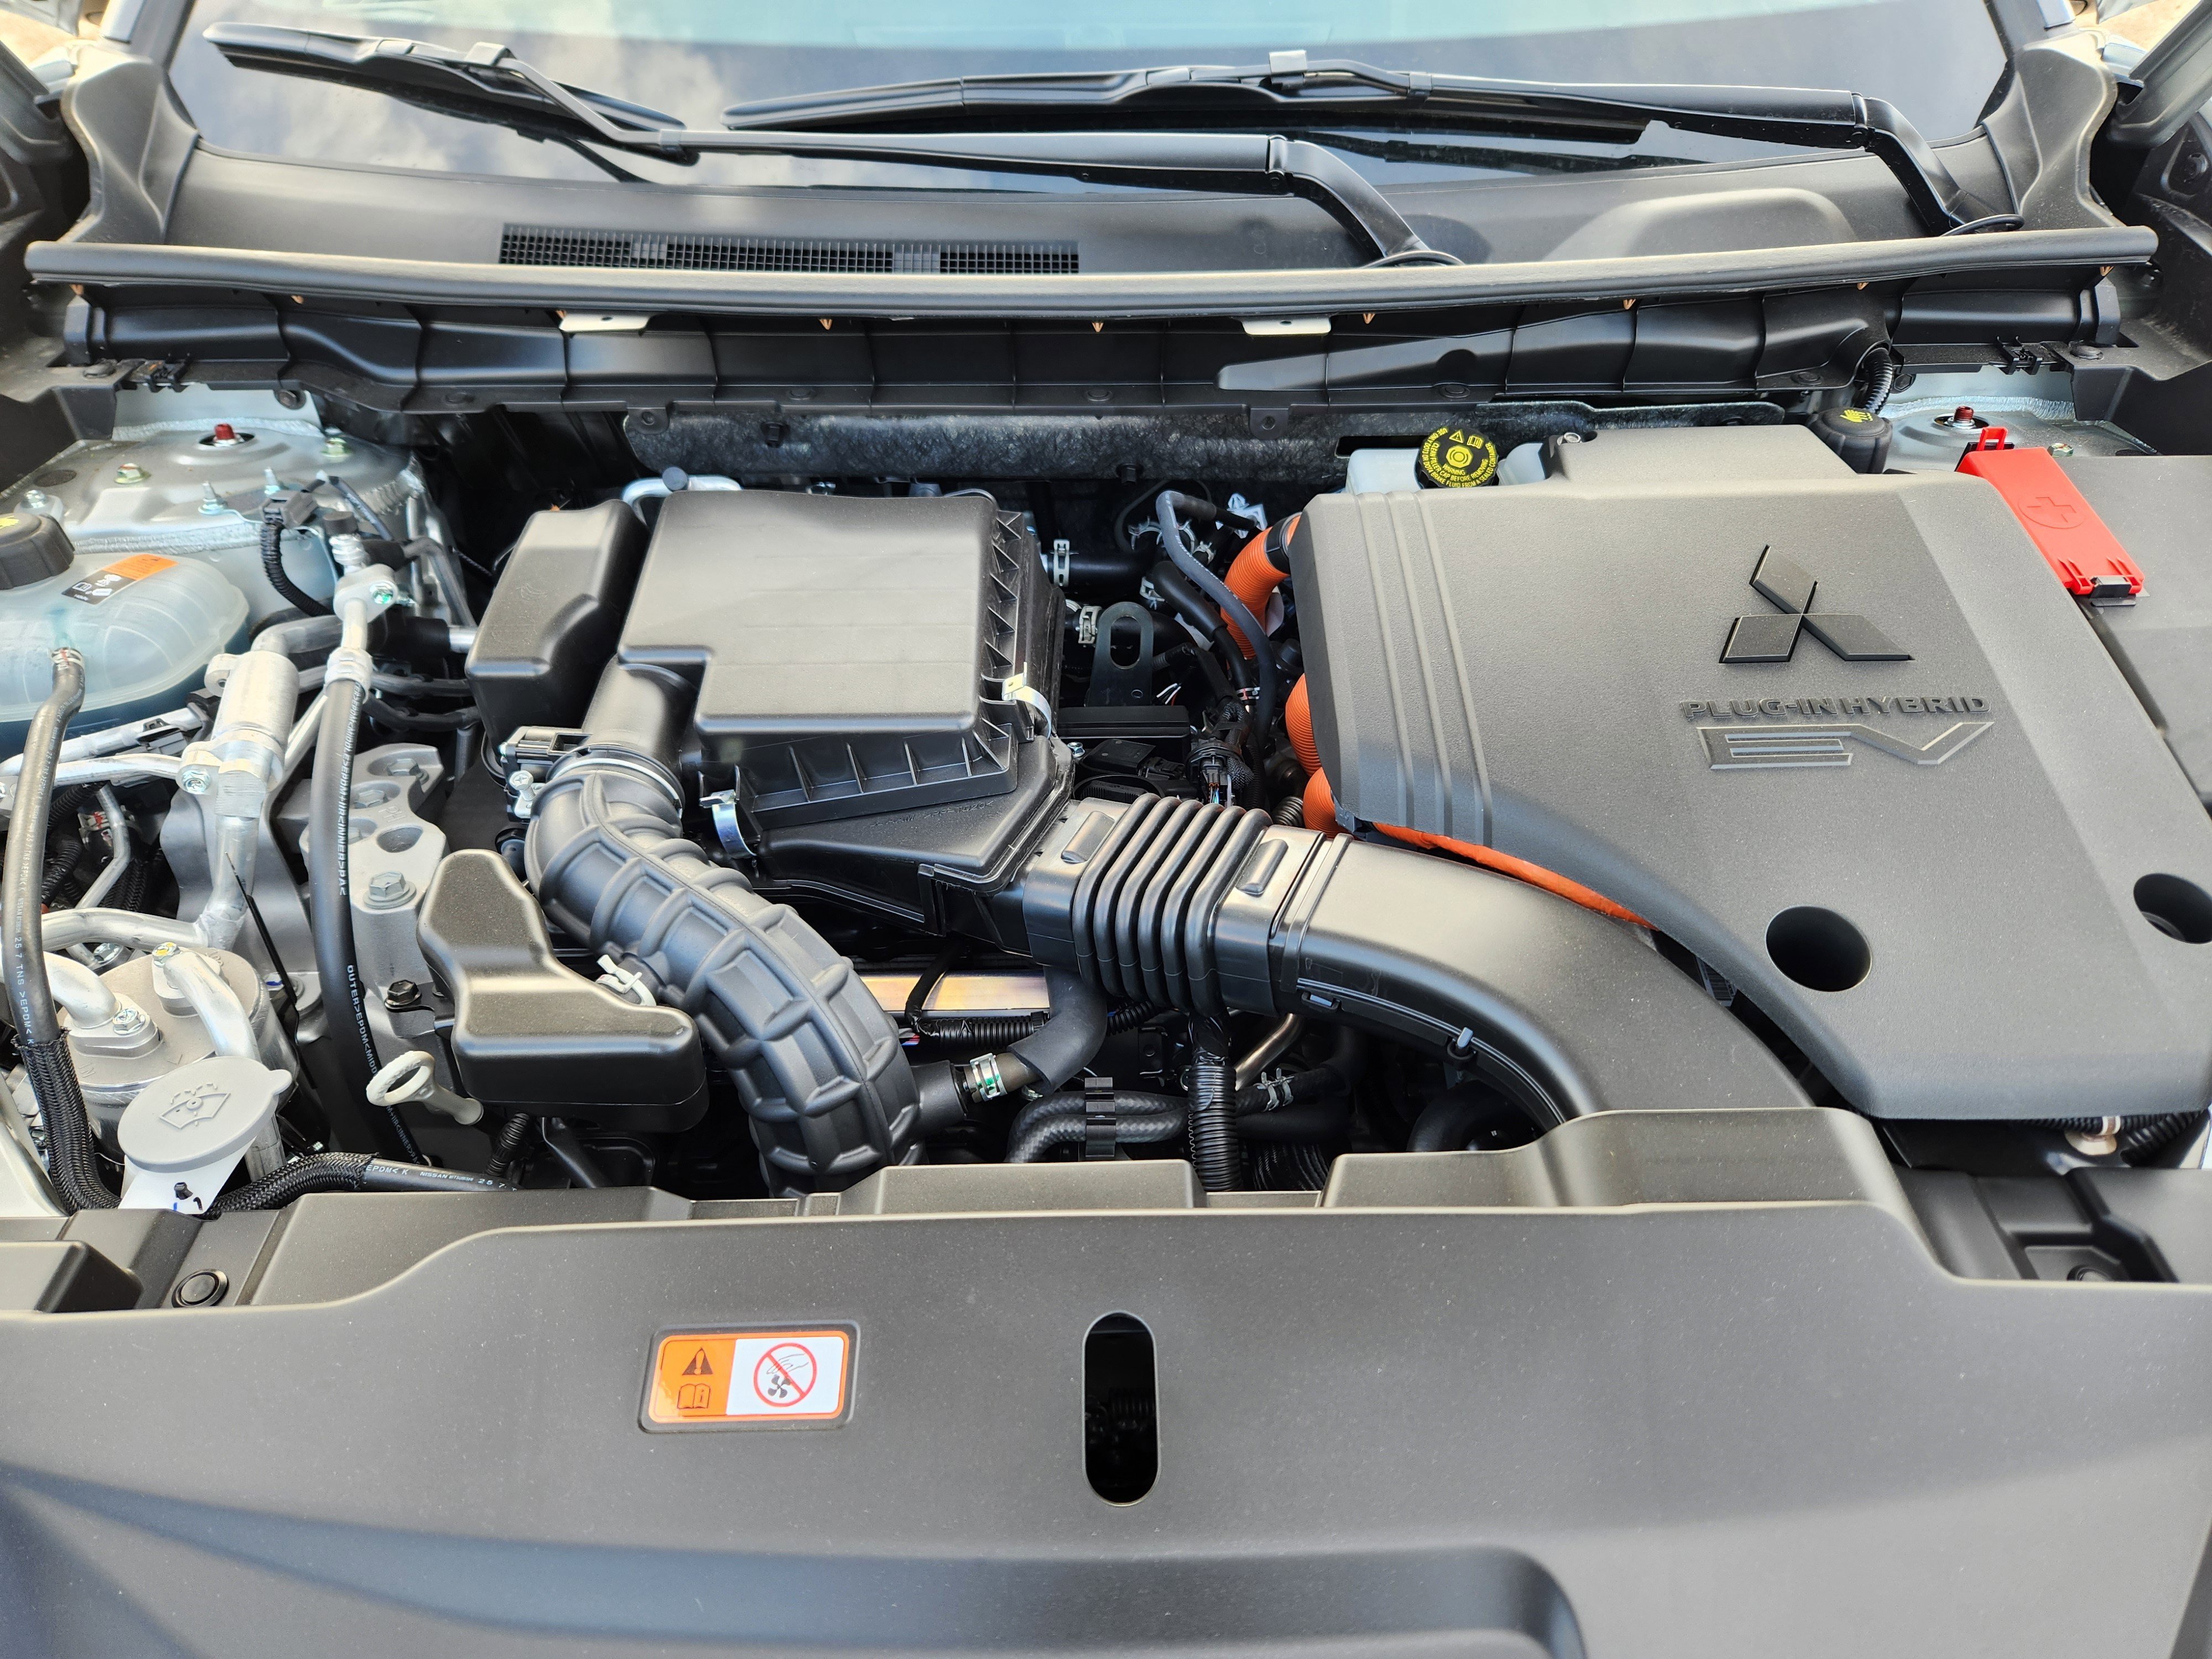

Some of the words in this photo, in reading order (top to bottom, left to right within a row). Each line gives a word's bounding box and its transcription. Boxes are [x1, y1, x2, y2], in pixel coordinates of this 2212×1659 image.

[1427, 433, 1438, 444] ONLY
[1438, 427, 1448, 436] USE
[1430, 443, 1440, 457] CLEAN
[1485, 442, 1497, 469] CONTAINER
[1430, 457, 1441, 472] FILLER
[1443, 463, 1465, 476] WARNING
[1471, 459, 1488, 479] REMOVING
[1431, 472, 1446, 484] BRAKE
[1479, 469, 1493, 482] SEALED
[1680, 697, 1837, 718] PLUG-IN
[1840, 696, 1991, 714] HYBRID
[1697, 722, 1994, 769] EV
[16, 964, 24, 985] TNS
